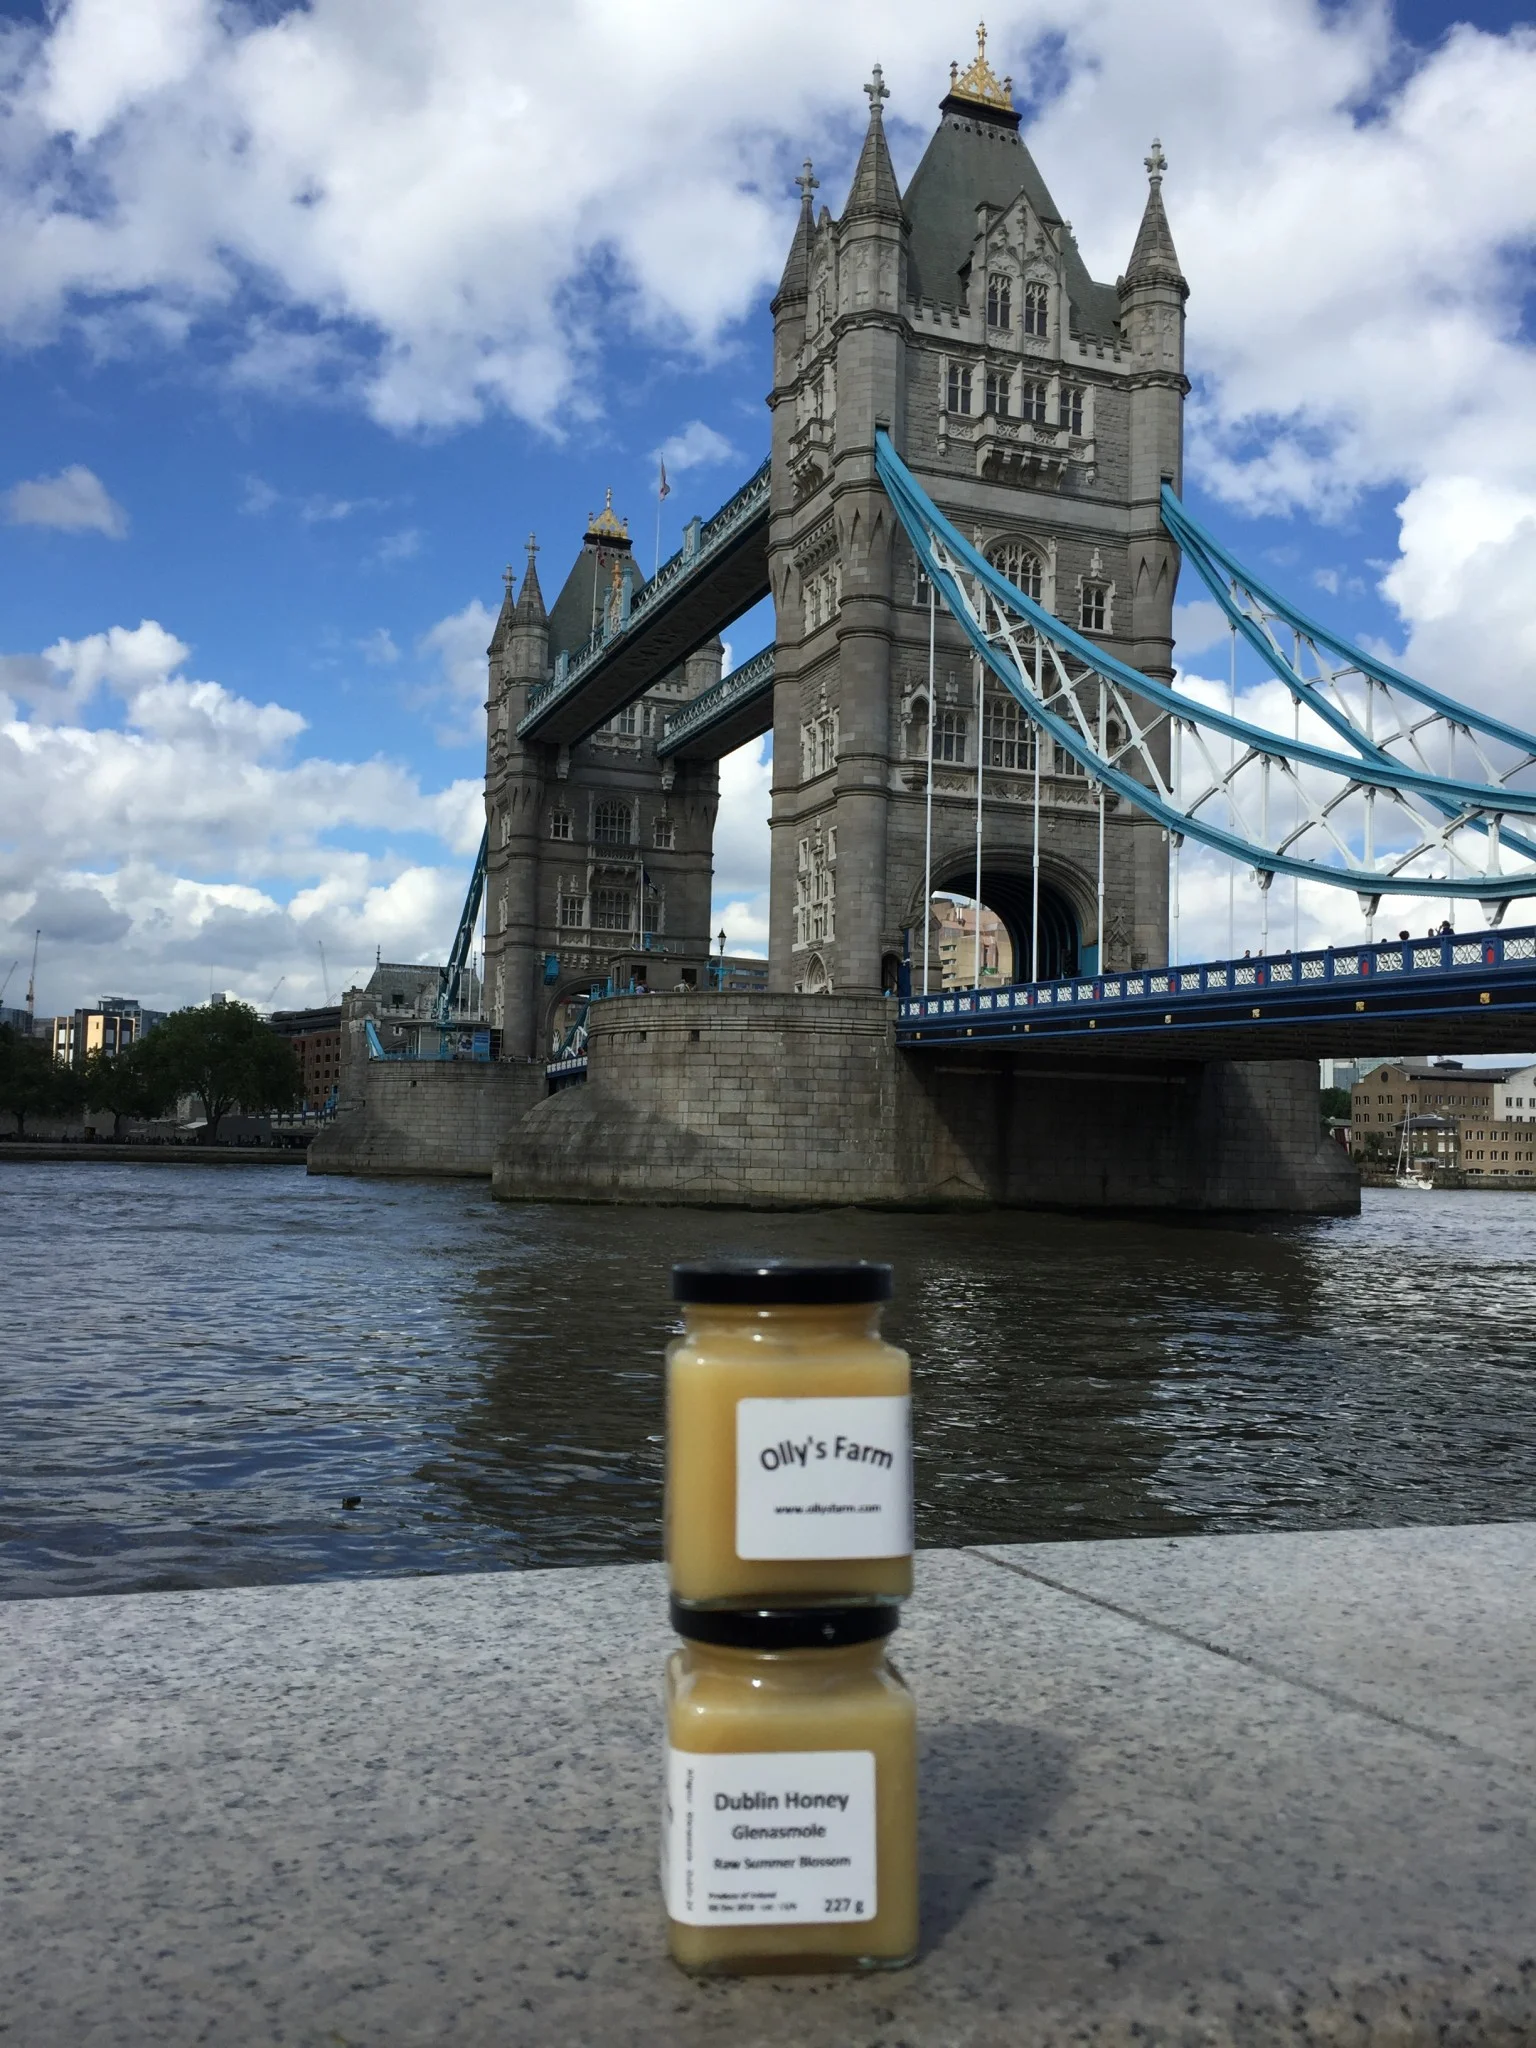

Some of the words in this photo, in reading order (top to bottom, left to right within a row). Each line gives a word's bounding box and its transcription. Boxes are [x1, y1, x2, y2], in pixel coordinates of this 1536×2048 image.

[760, 1436, 828, 1471] Olly's
[834, 1436, 894, 1470] Farm
[714, 1792, 779, 1811] Dublin
[785, 1792, 849, 1812] Honey
[731, 1824, 826, 1840] Glenasmole
[713, 1859, 741, 1870] Raw
[744, 1858, 796, 1870] Summer
[799, 1857, 851, 1867] Blossom
[824, 1898, 851, 1913] 227
[854, 1900, 864, 1914] g
